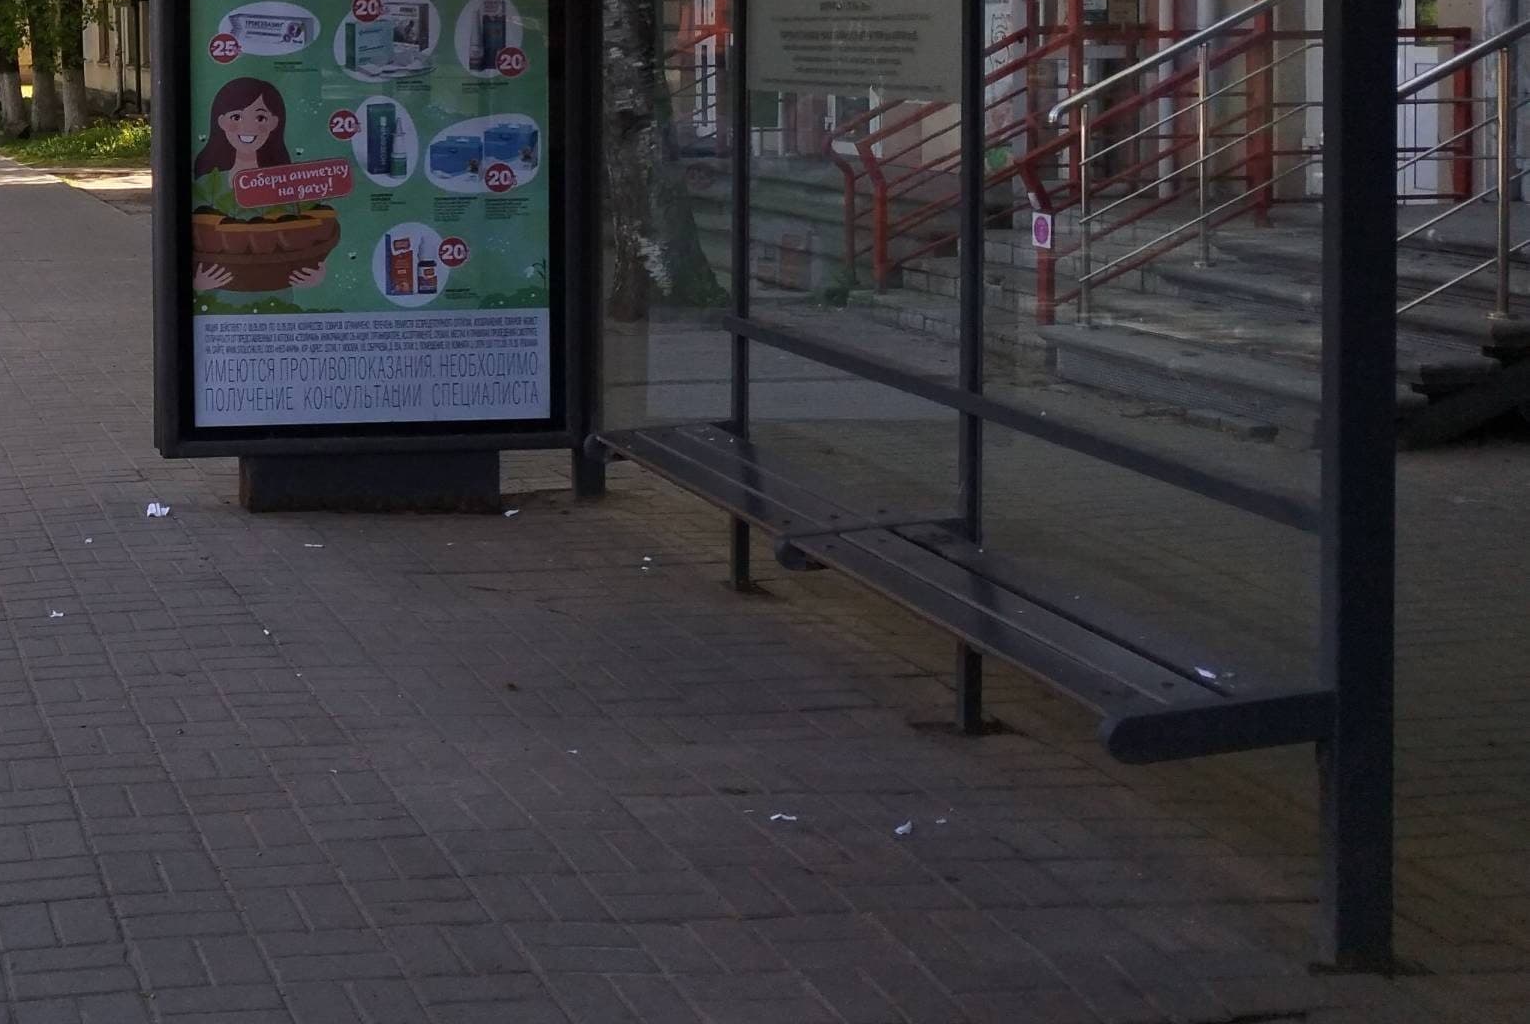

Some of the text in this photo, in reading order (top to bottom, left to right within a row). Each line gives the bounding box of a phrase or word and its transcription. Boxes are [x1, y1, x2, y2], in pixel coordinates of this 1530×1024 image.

[239, 164, 349, 191] Собери аптечку
[278, 178, 333, 200] на дачу!
[205, 357, 275, 383] ИМЕЮТСЯ
[440, 351, 539, 379] НЕОБХОДИМО
[205, 381, 539, 412] ПОЛУЧЕНИЕ КОНСУЛЬТАЦИИ СПЕЦИАЛИСТА
